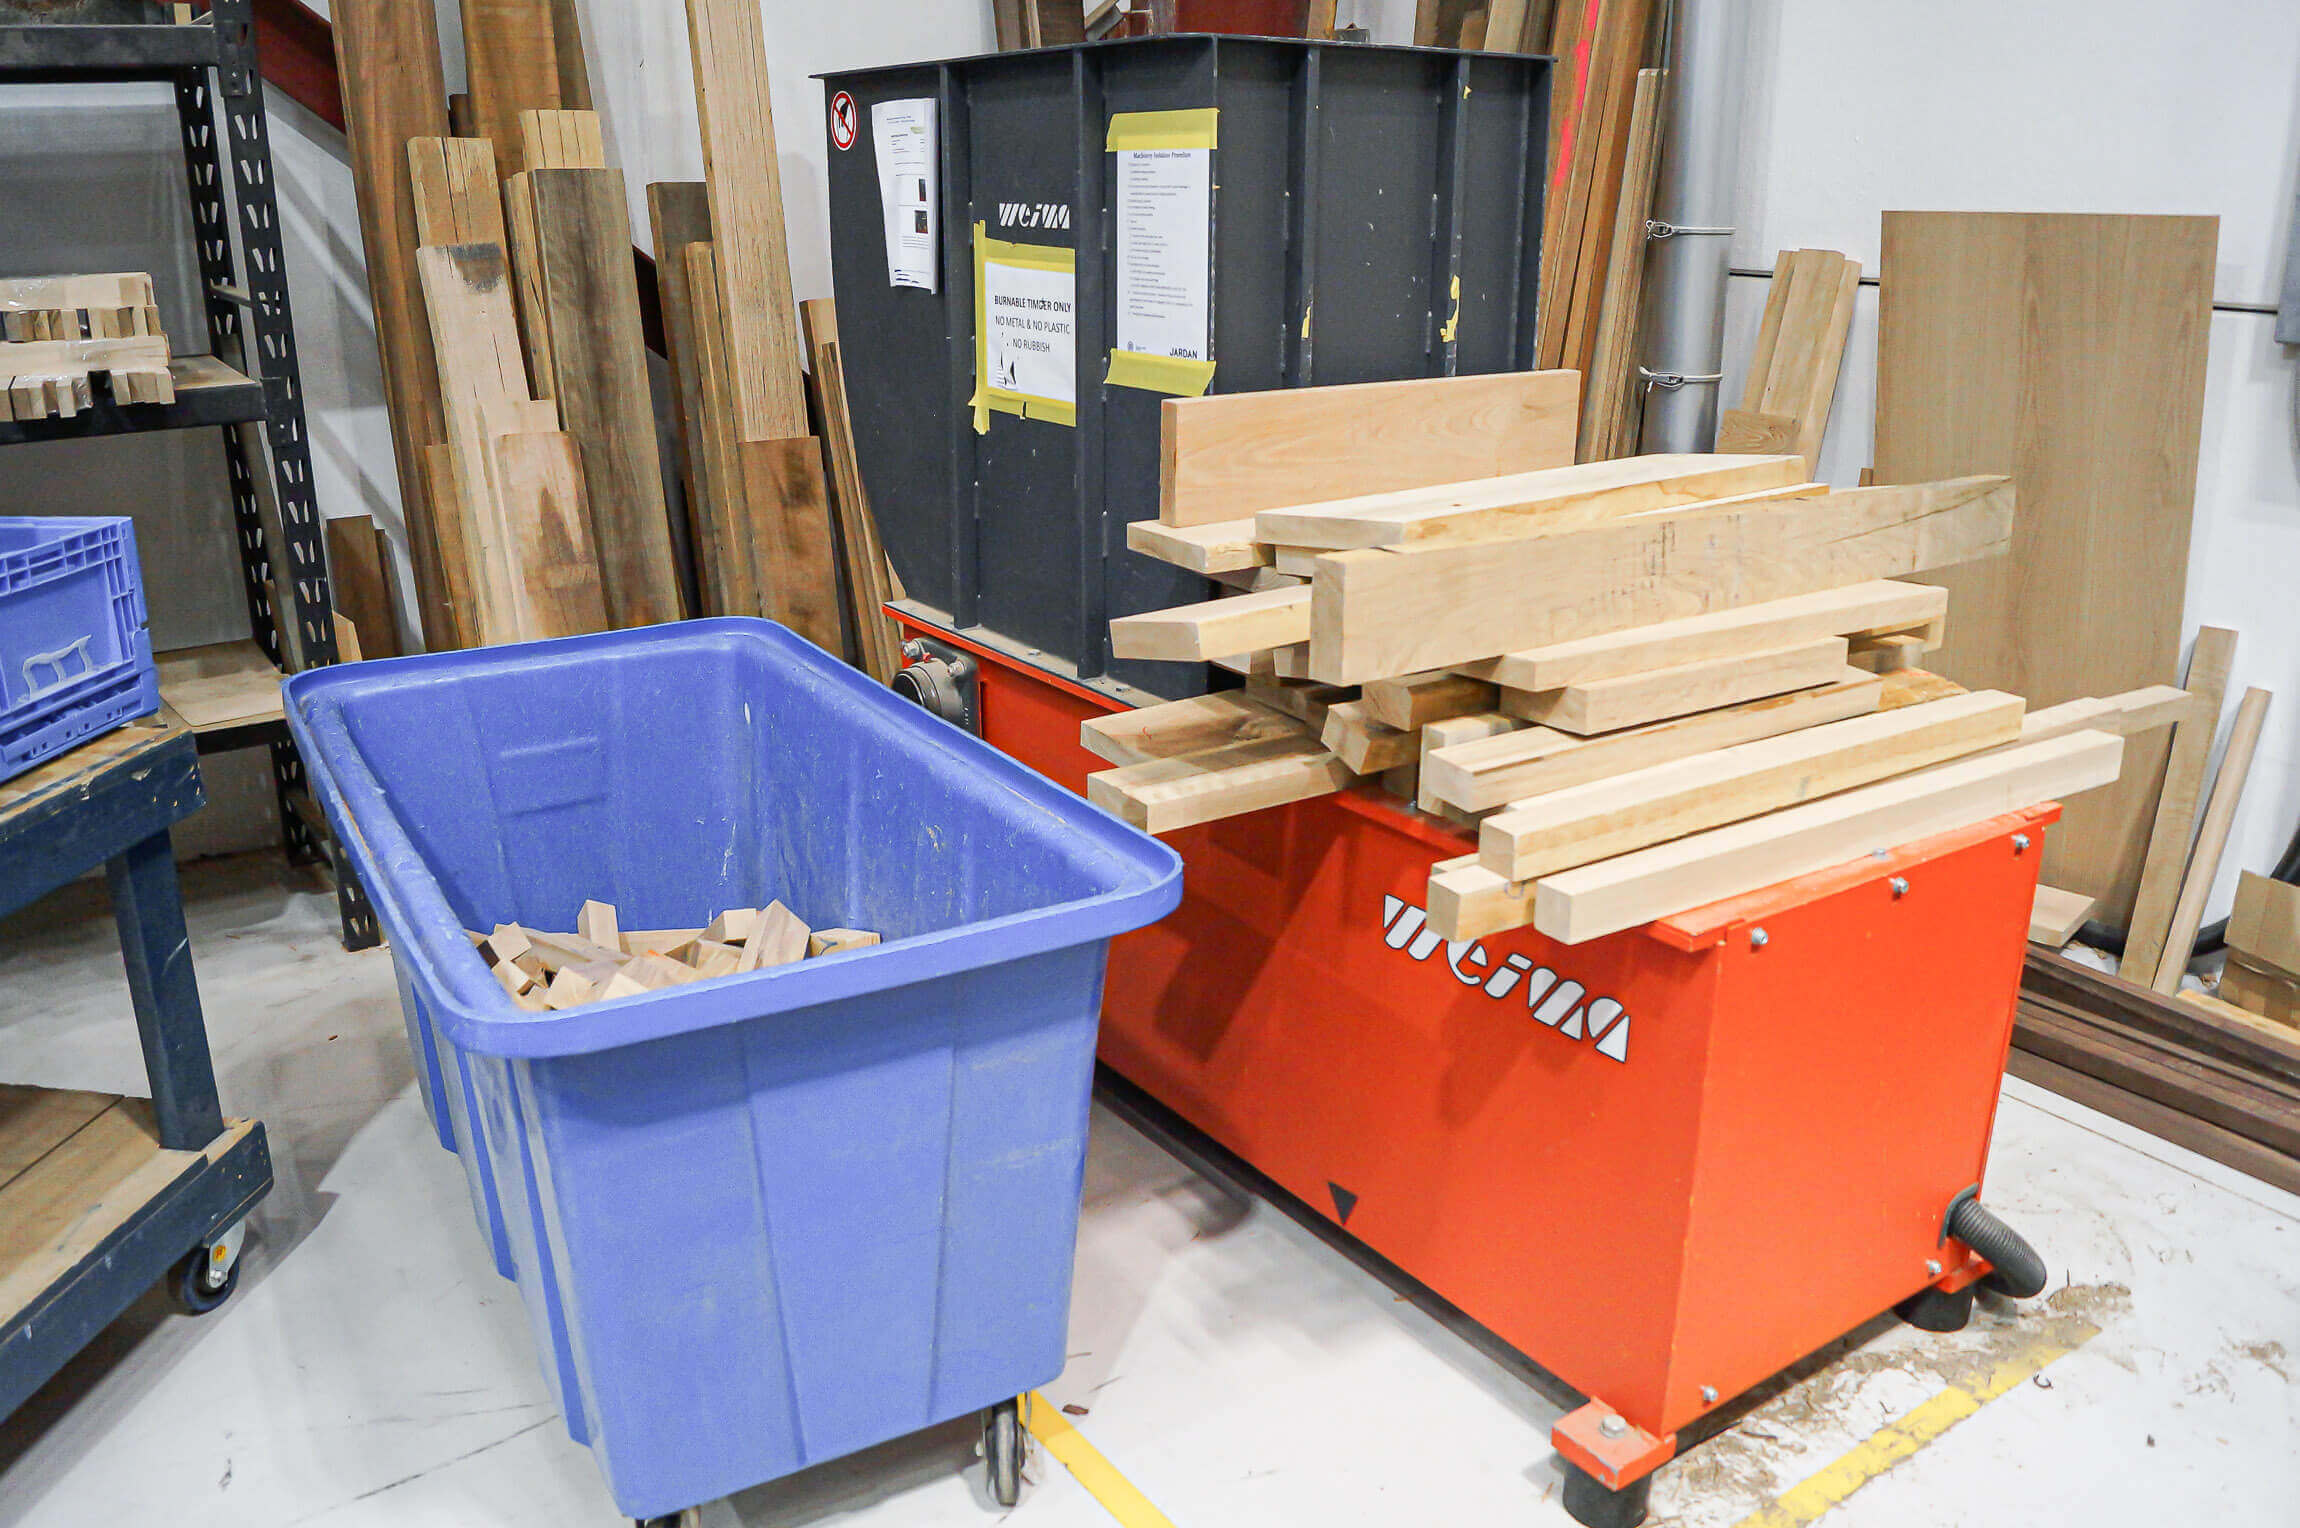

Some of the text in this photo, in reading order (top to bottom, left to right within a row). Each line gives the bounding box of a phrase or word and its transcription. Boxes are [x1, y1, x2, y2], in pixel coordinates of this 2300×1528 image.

[994, 295, 1027, 309] BURNABLE
[1053, 302, 1071, 313] ONLY
[995, 315, 1071, 335] NO METAL & NO PLASTIC
[1012, 338, 1050, 353] NO RUBBISH
[1169, 347, 1198, 360] JARDAN
